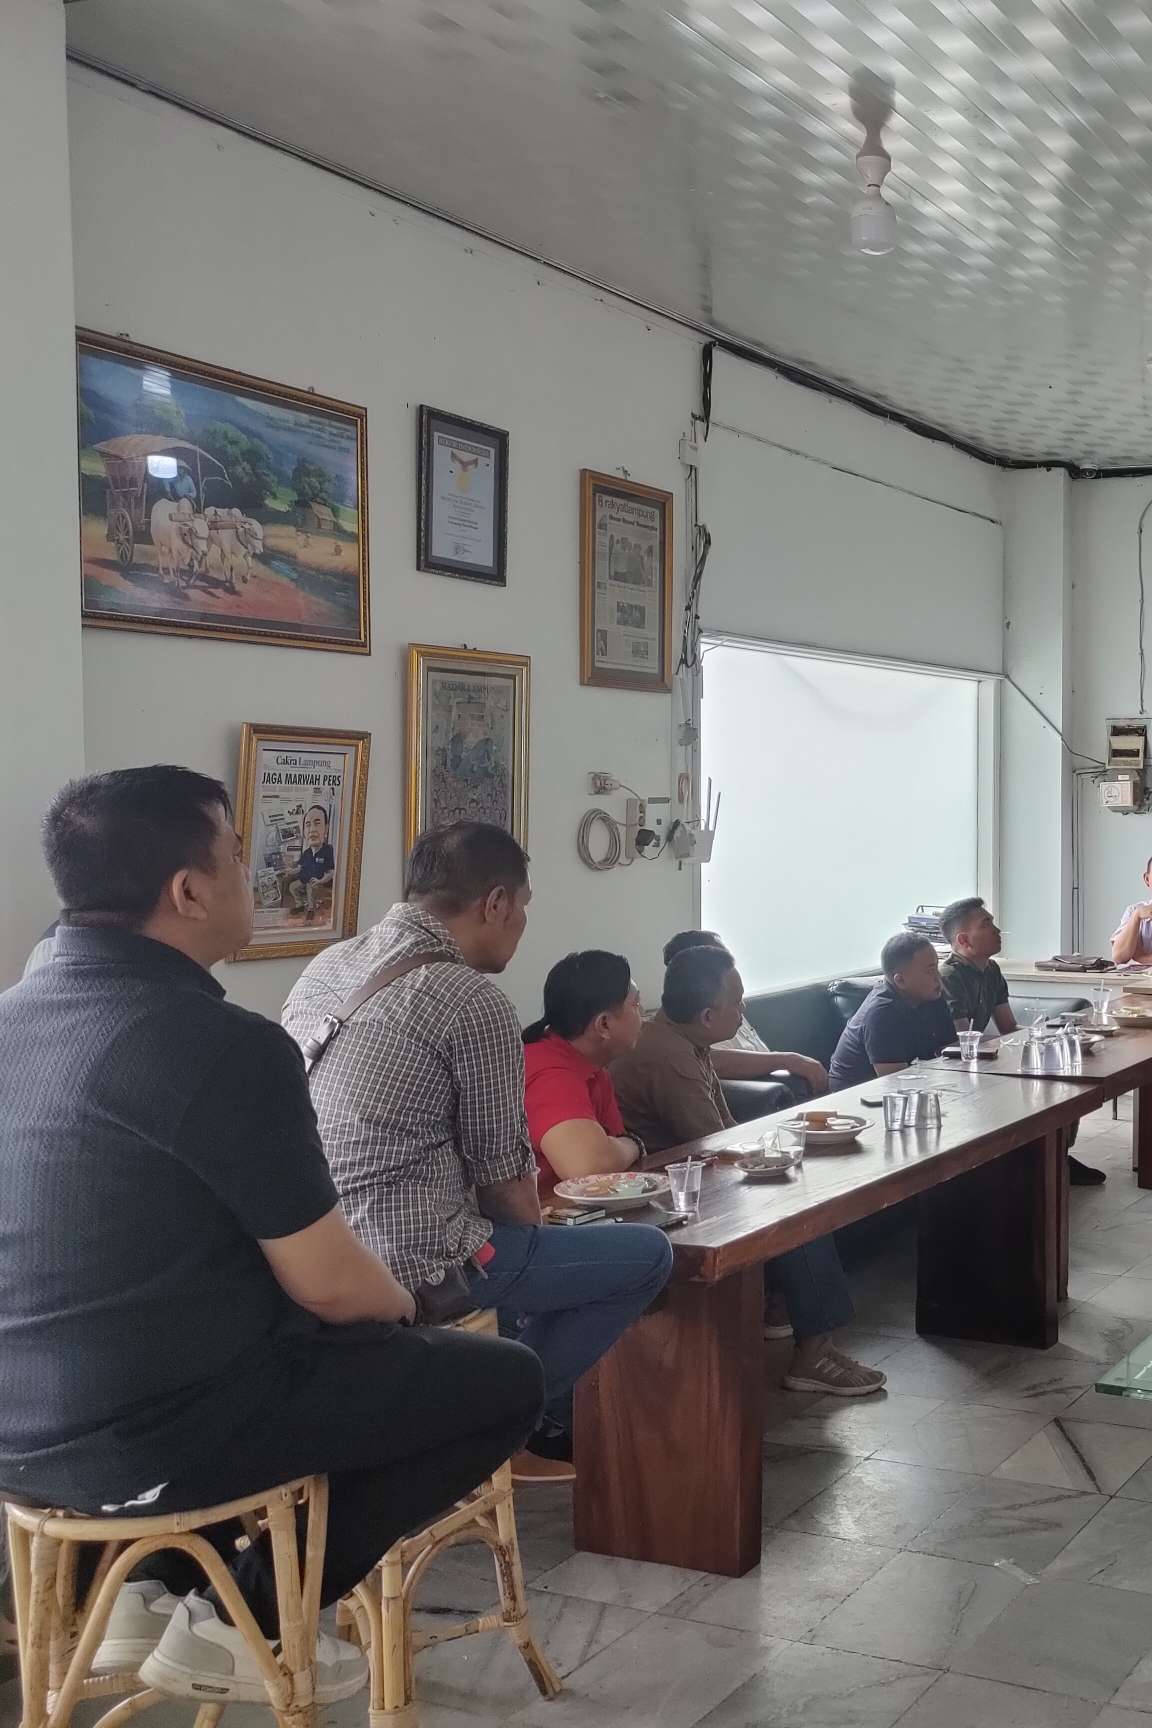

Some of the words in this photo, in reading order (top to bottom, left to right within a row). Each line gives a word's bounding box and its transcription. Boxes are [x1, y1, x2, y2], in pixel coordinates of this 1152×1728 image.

[276, 755, 297, 766] Cakra
[298, 757, 331, 768] Lampung
[262, 772, 282, 785] JAGA
[285, 773, 320, 786] MARWAH
[323, 775, 341, 787] PERS
